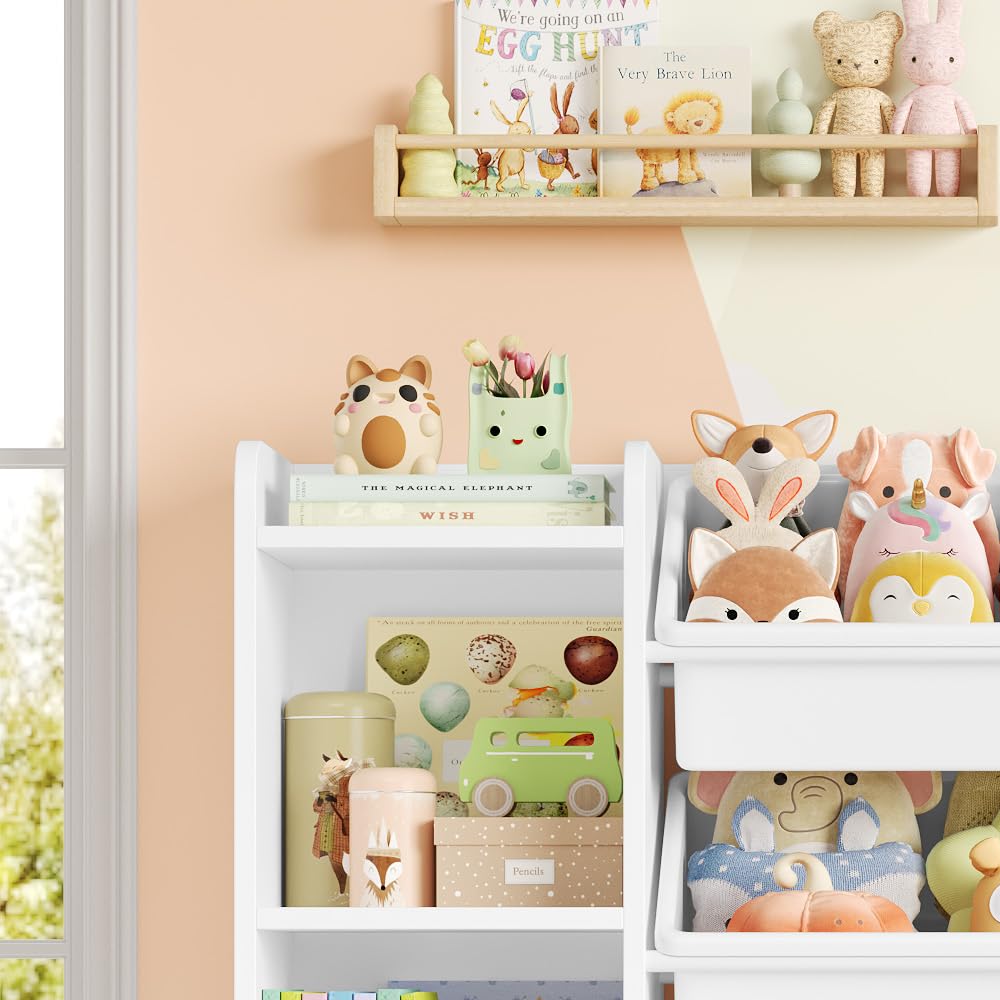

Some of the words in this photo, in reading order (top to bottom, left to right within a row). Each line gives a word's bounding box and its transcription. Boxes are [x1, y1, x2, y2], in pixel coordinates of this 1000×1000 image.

[498, 8, 534, 25] We're
[540, 13, 579, 29] going
[584, 13, 602, 24] on
[607, 11, 625, 22] an
[475, 23, 542, 61] EGG
[552, 23, 648, 62] HUNT
[664, 51, 687, 62] The
[617, 68, 649, 84] Very
[657, 68, 695, 80] Brave
[702, 68, 733, 80] Lion
[419, 511, 475, 520] WISH
[513, 867, 544, 876] Pencils
